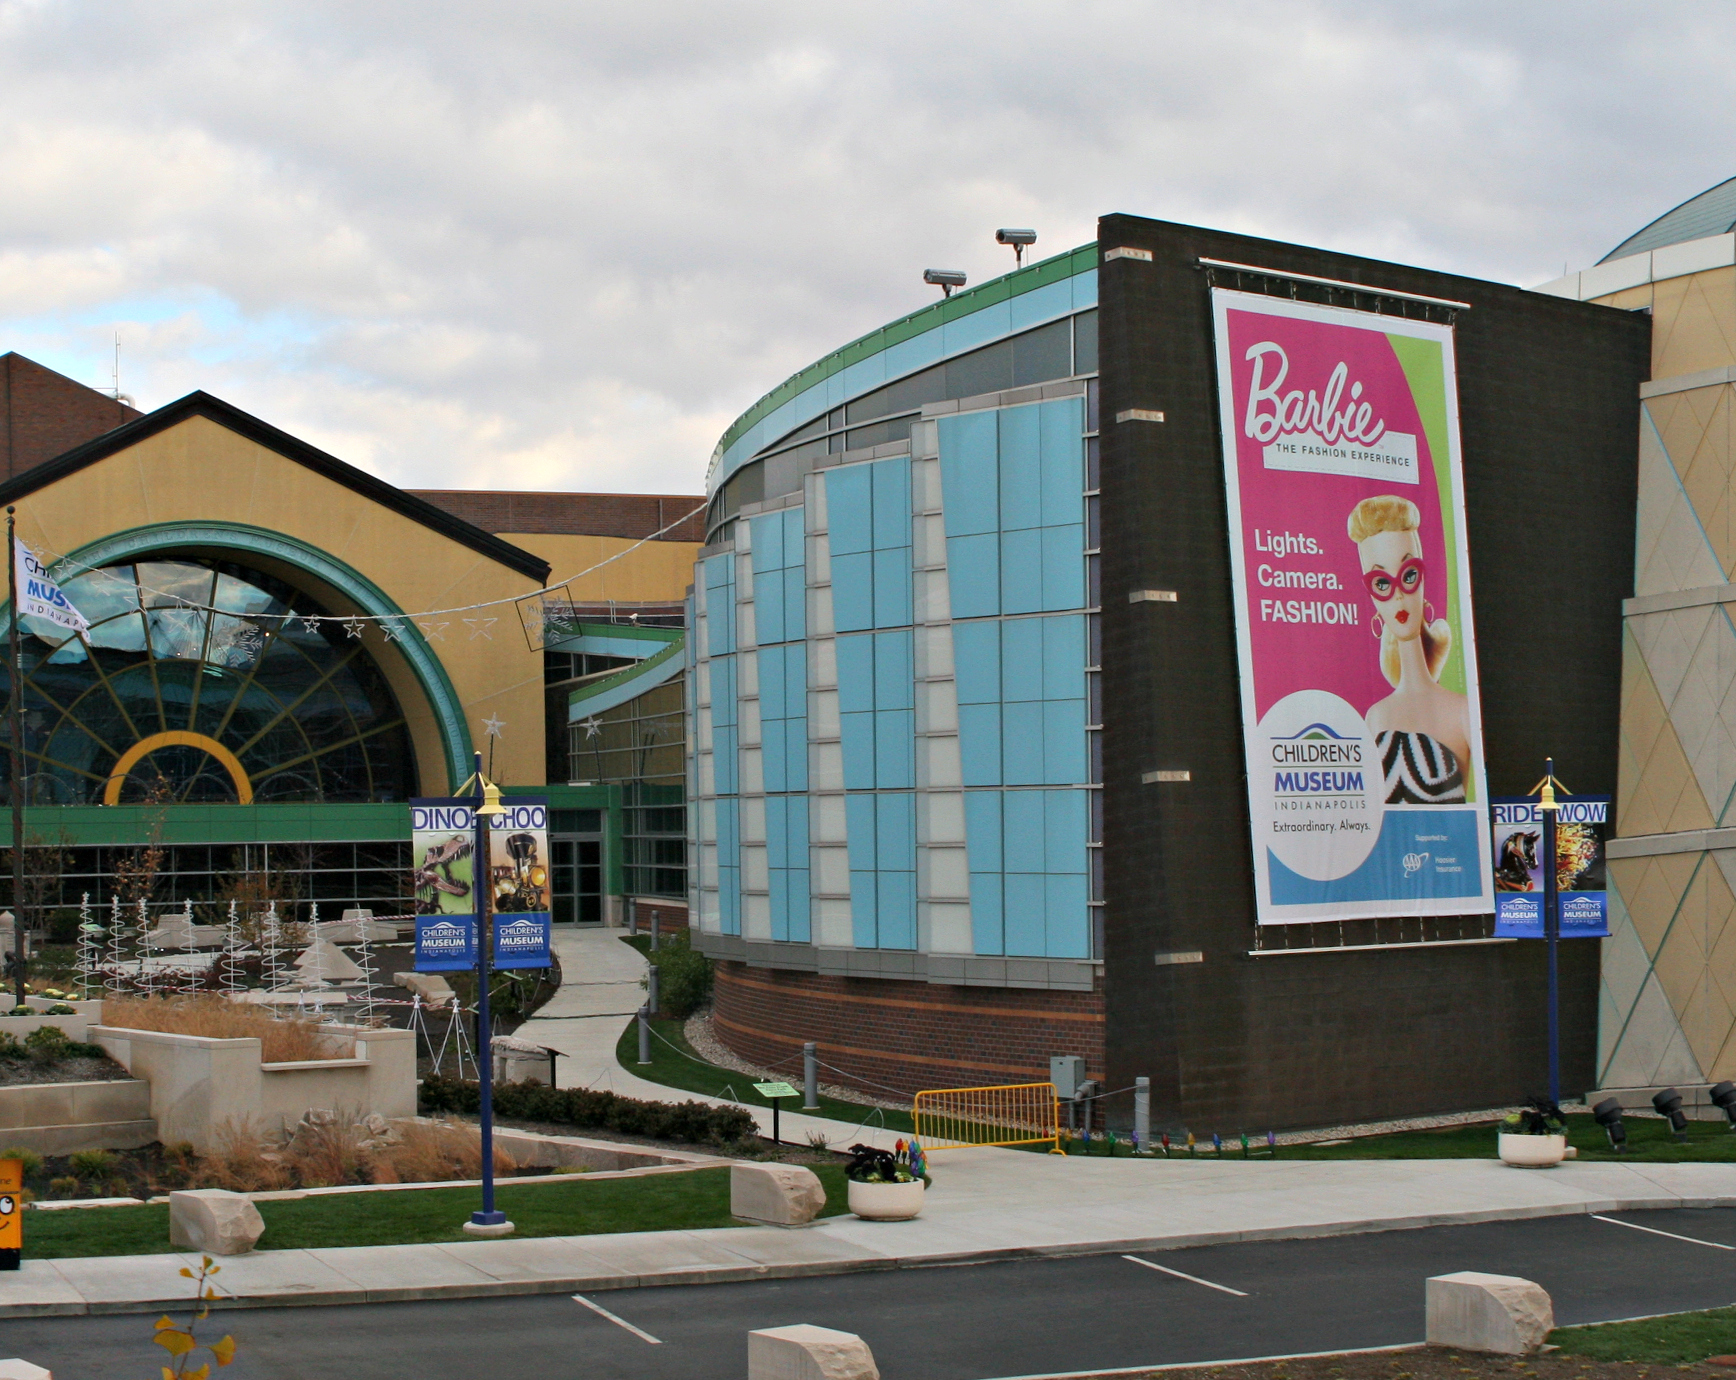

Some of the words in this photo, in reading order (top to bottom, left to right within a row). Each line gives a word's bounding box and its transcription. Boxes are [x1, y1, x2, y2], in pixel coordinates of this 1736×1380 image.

[1244, 341, 1384, 443] Barbie
[1276, 443, 1296, 454] THE
[1302, 445, 1346, 458] FASHION
[1351, 450, 1410, 466] EXPERIENCE
[1254, 529, 1324, 558] Lights.
[1258, 564, 1343, 590] Camera.
[28, 579, 71, 610] MUS
[1260, 599, 1358, 626] FASHION!
[1272, 744, 1362, 762] CHILDREN'S
[1274, 772, 1364, 792] MUSEUM
[1274, 800, 1366, 810] INDIANAPOLIS
[1494, 805, 1543, 823] RIDE
[1558, 804, 1606, 822] WOW
[414, 807, 470, 830] DINO
[490, 807, 546, 829] CHOO
[1273, 820, 1336, 834] Extraordinary.
[1340, 818, 1370, 833] Always.
[422, 929, 466, 937] CHILDREN'S
[500, 926, 544, 935] CHILDREN'S
[422, 938, 465, 947] MUSEUM
[500, 936, 544, 945] MUSEUM
